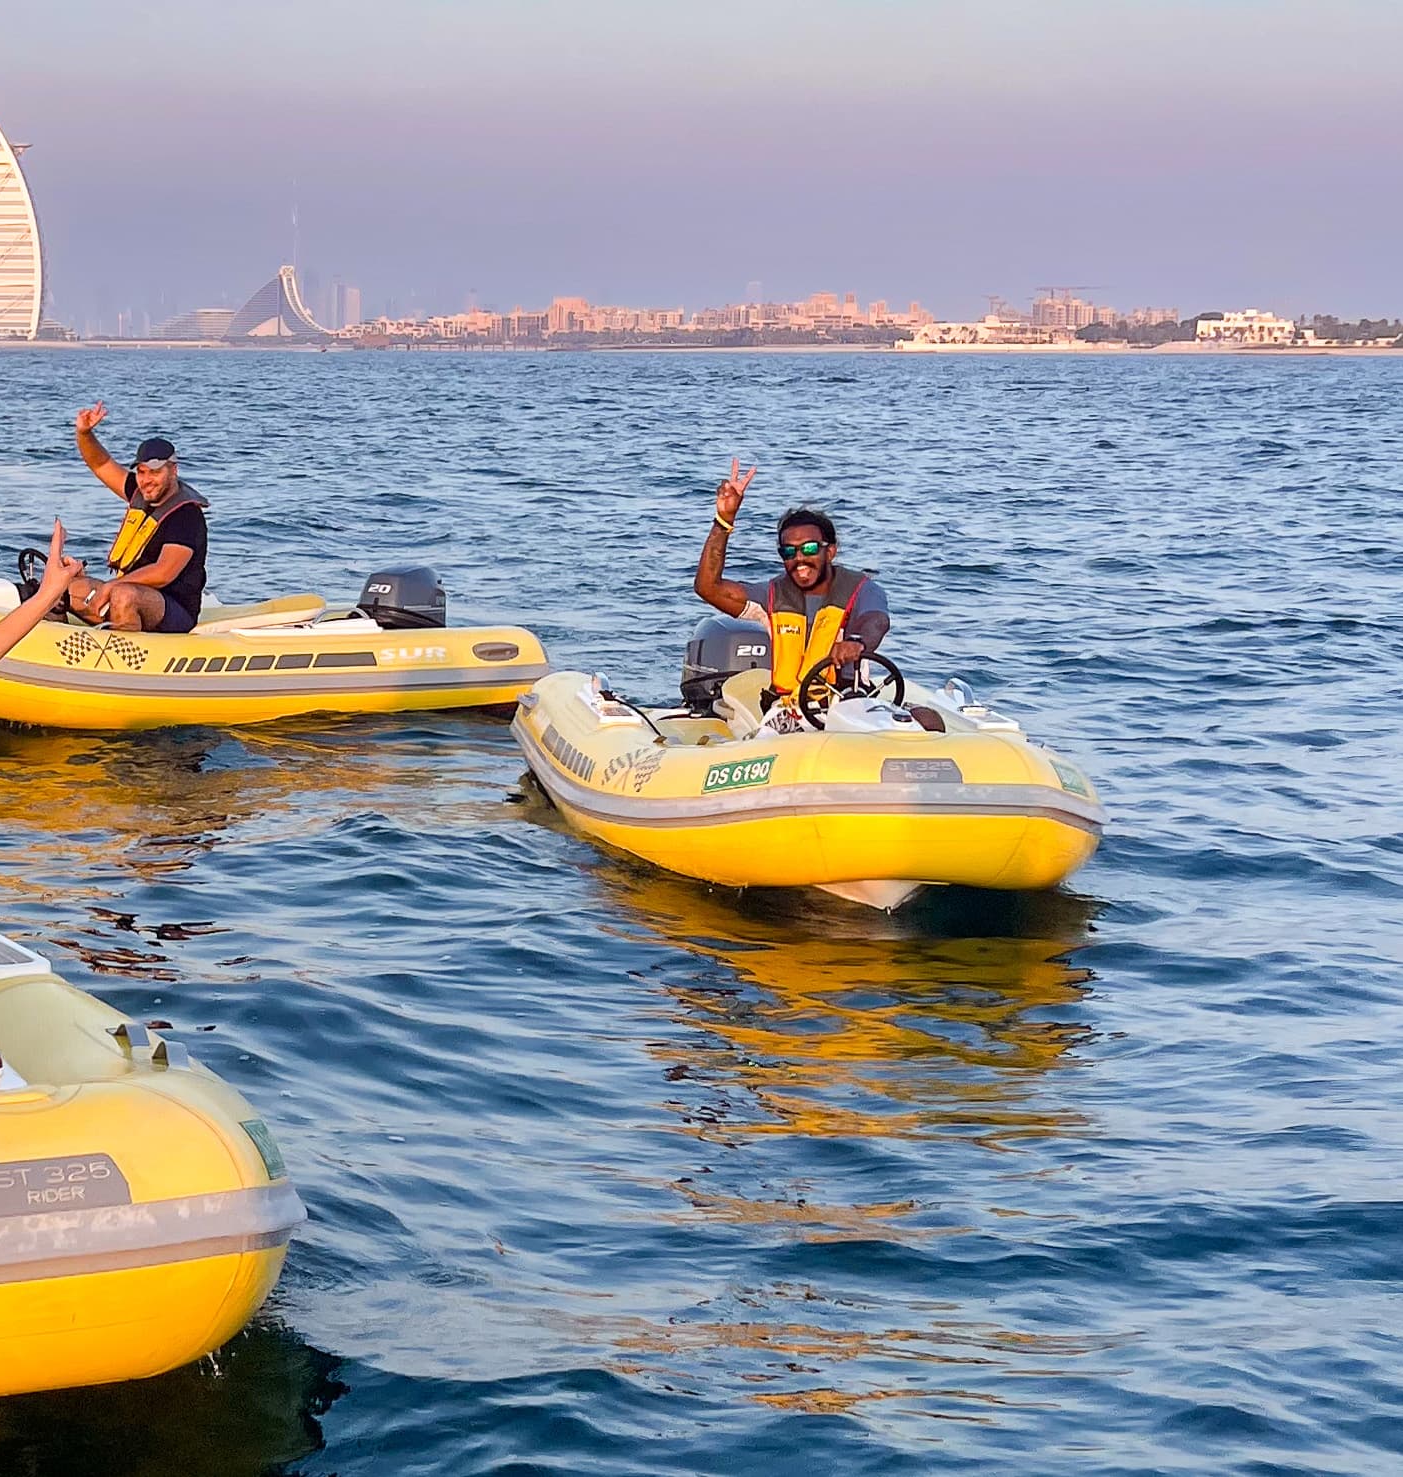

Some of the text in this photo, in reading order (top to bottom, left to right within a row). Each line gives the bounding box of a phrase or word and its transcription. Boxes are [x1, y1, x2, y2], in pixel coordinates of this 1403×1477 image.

[367, 583, 392, 594] 20
[736, 645, 767, 657] 20
[706, 761, 771, 787] DS 6190
[44, 1161, 111, 1184] 325
[26, 1185, 86, 1205] RIDER
